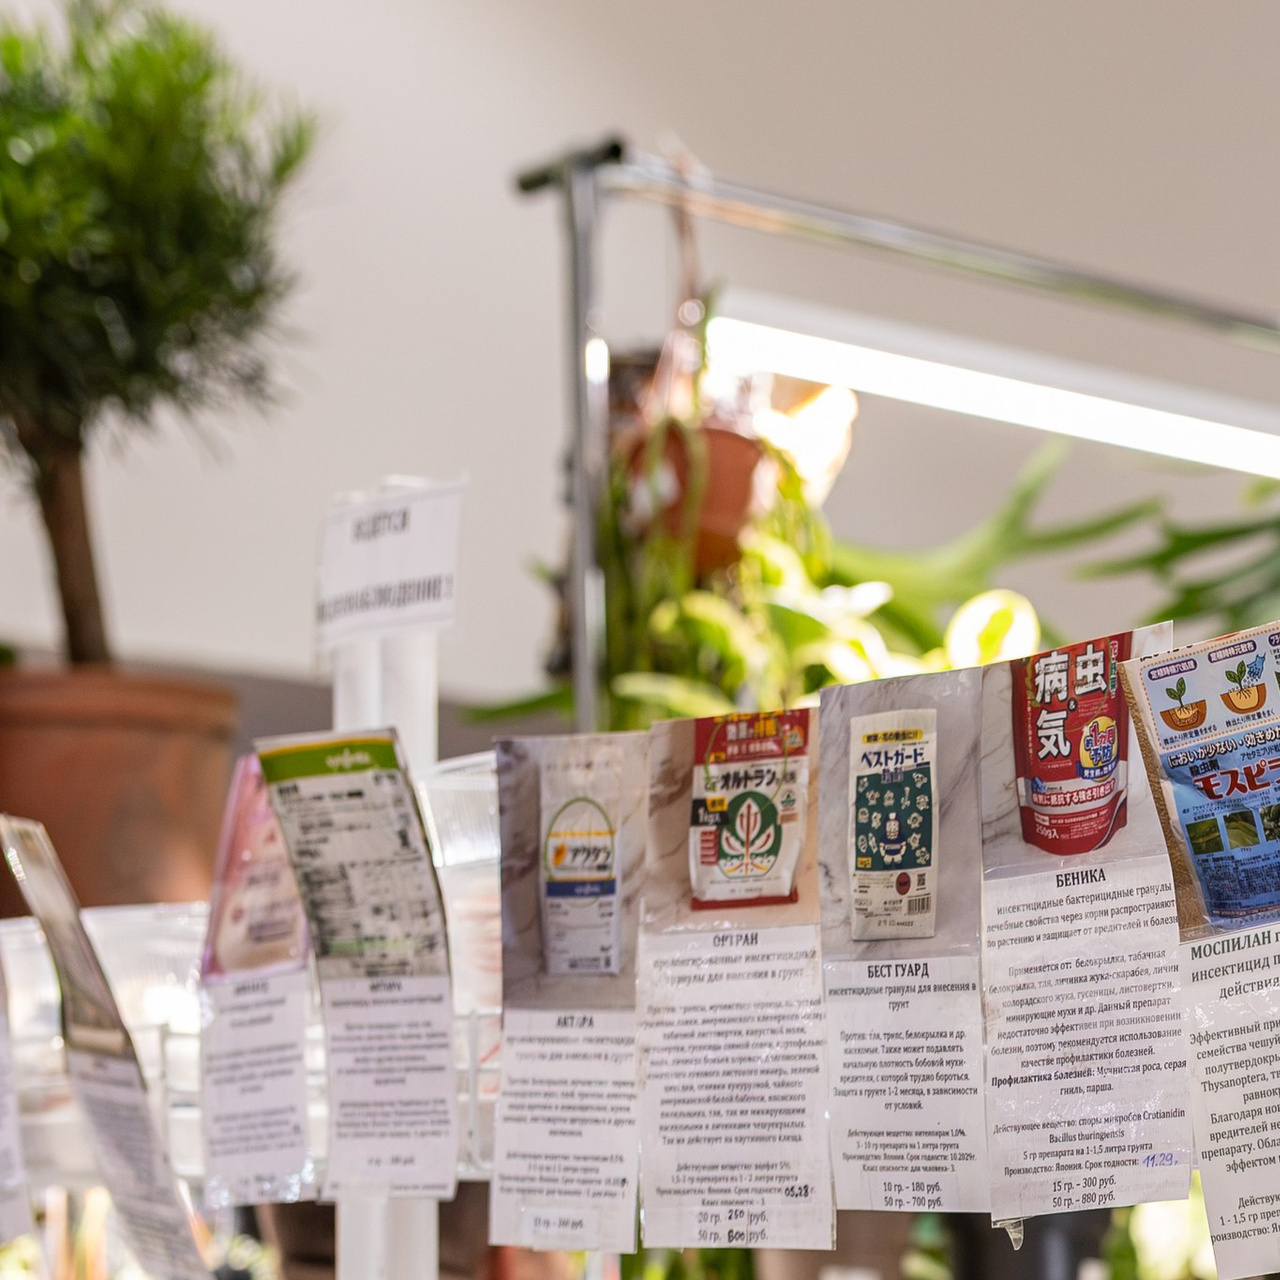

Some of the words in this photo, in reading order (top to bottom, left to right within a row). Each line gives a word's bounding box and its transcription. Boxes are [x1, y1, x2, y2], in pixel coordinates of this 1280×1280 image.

[1074, 643, 1107, 696] 虫
[1035, 650, 1072, 759] 病気
[1056, 868, 1106, 888] БЕНИКА
[997, 898, 1063, 915] инсектицидные
[1065, 888, 1134, 905] бактерицидные
[1136, 878, 1172, 897] гранулы
[1191, 930, 1271, 960] МОСПИЛАН
[867, 964, 892, 978] БЕСТ
[895, 962, 929, 978] ГУАРД
[1192, 956, 1270, 982] инсектицид
[1218, 975, 1280, 1002] действия
[882, 1180, 893, 1193] 10
[892, 1182, 905, 1195] гр.
[910, 1180, 925, 1193] 180
[925, 1180, 942, 1195] руб.
[1052, 1179, 1063, 1193] 15
[1063, 1181, 1075, 1194] гр.
[1081, 1175, 1098, 1189] 300
[1097, 1173, 1117, 1190] руб.
